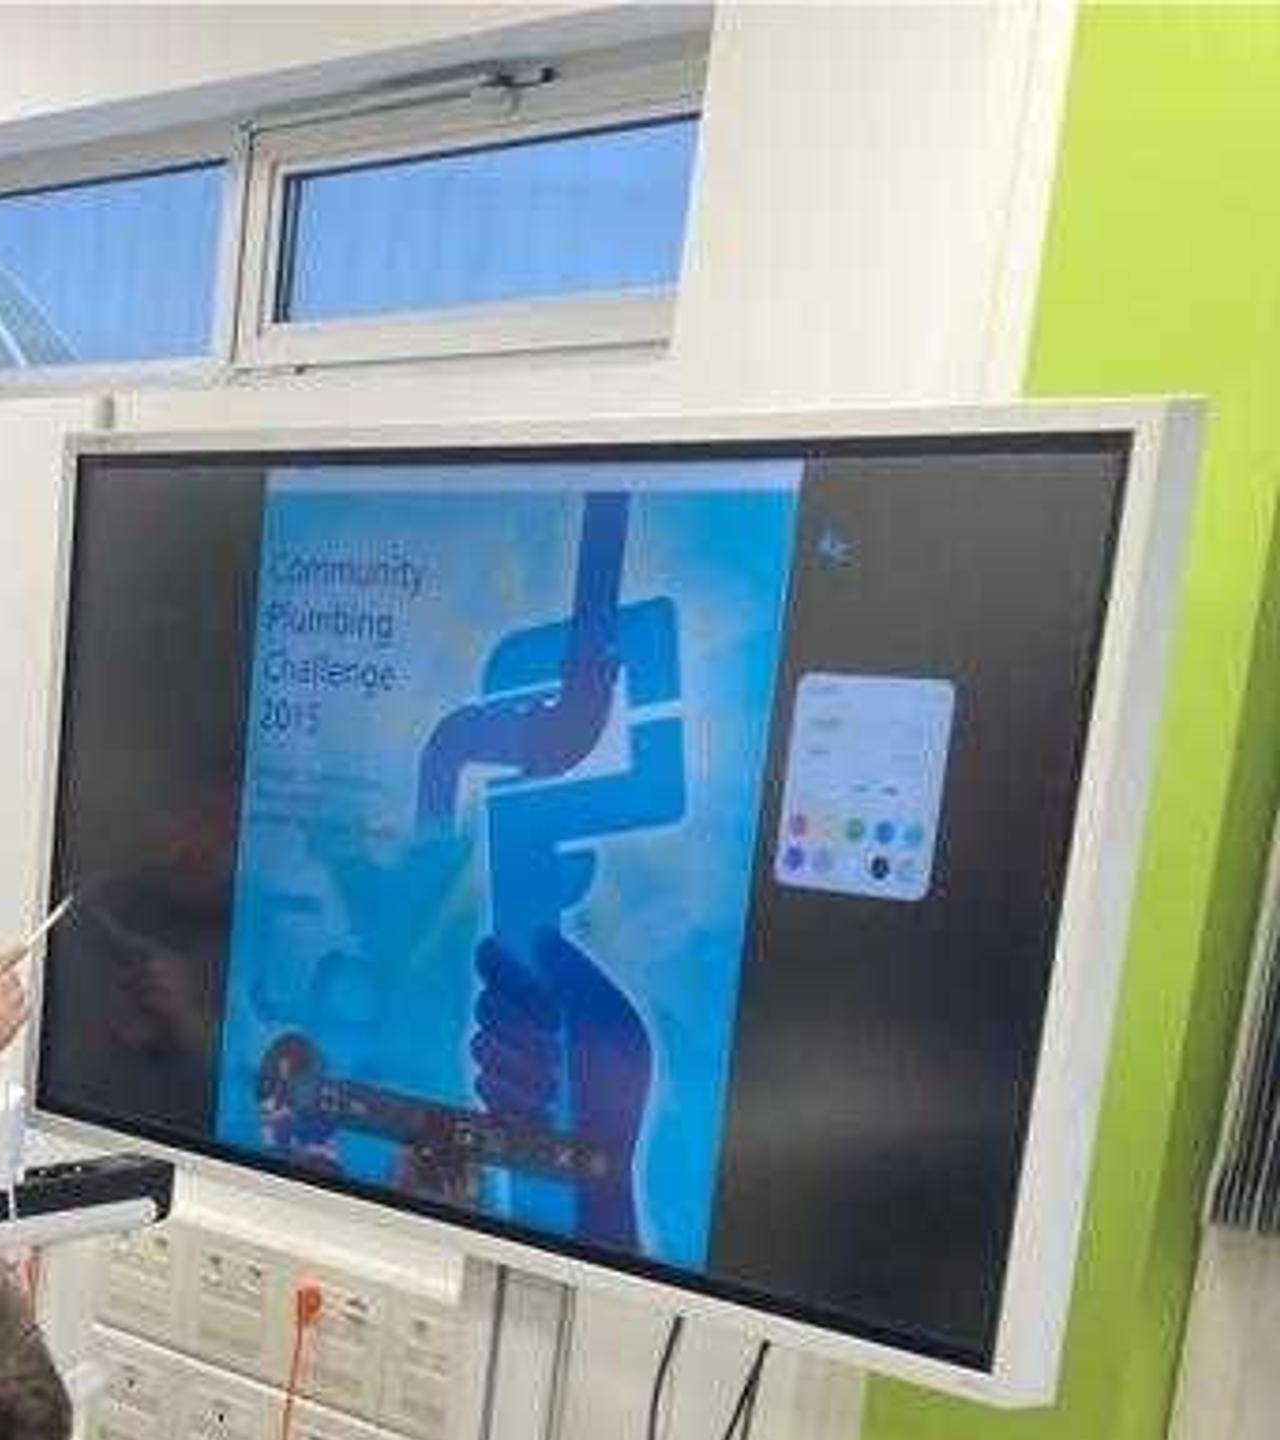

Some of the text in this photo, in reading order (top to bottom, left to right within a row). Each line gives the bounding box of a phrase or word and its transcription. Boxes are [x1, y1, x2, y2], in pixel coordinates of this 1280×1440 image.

[269, 550, 427, 598] Community
[263, 600, 393, 645] Plumbing
[263, 655, 398, 695] Challenge
